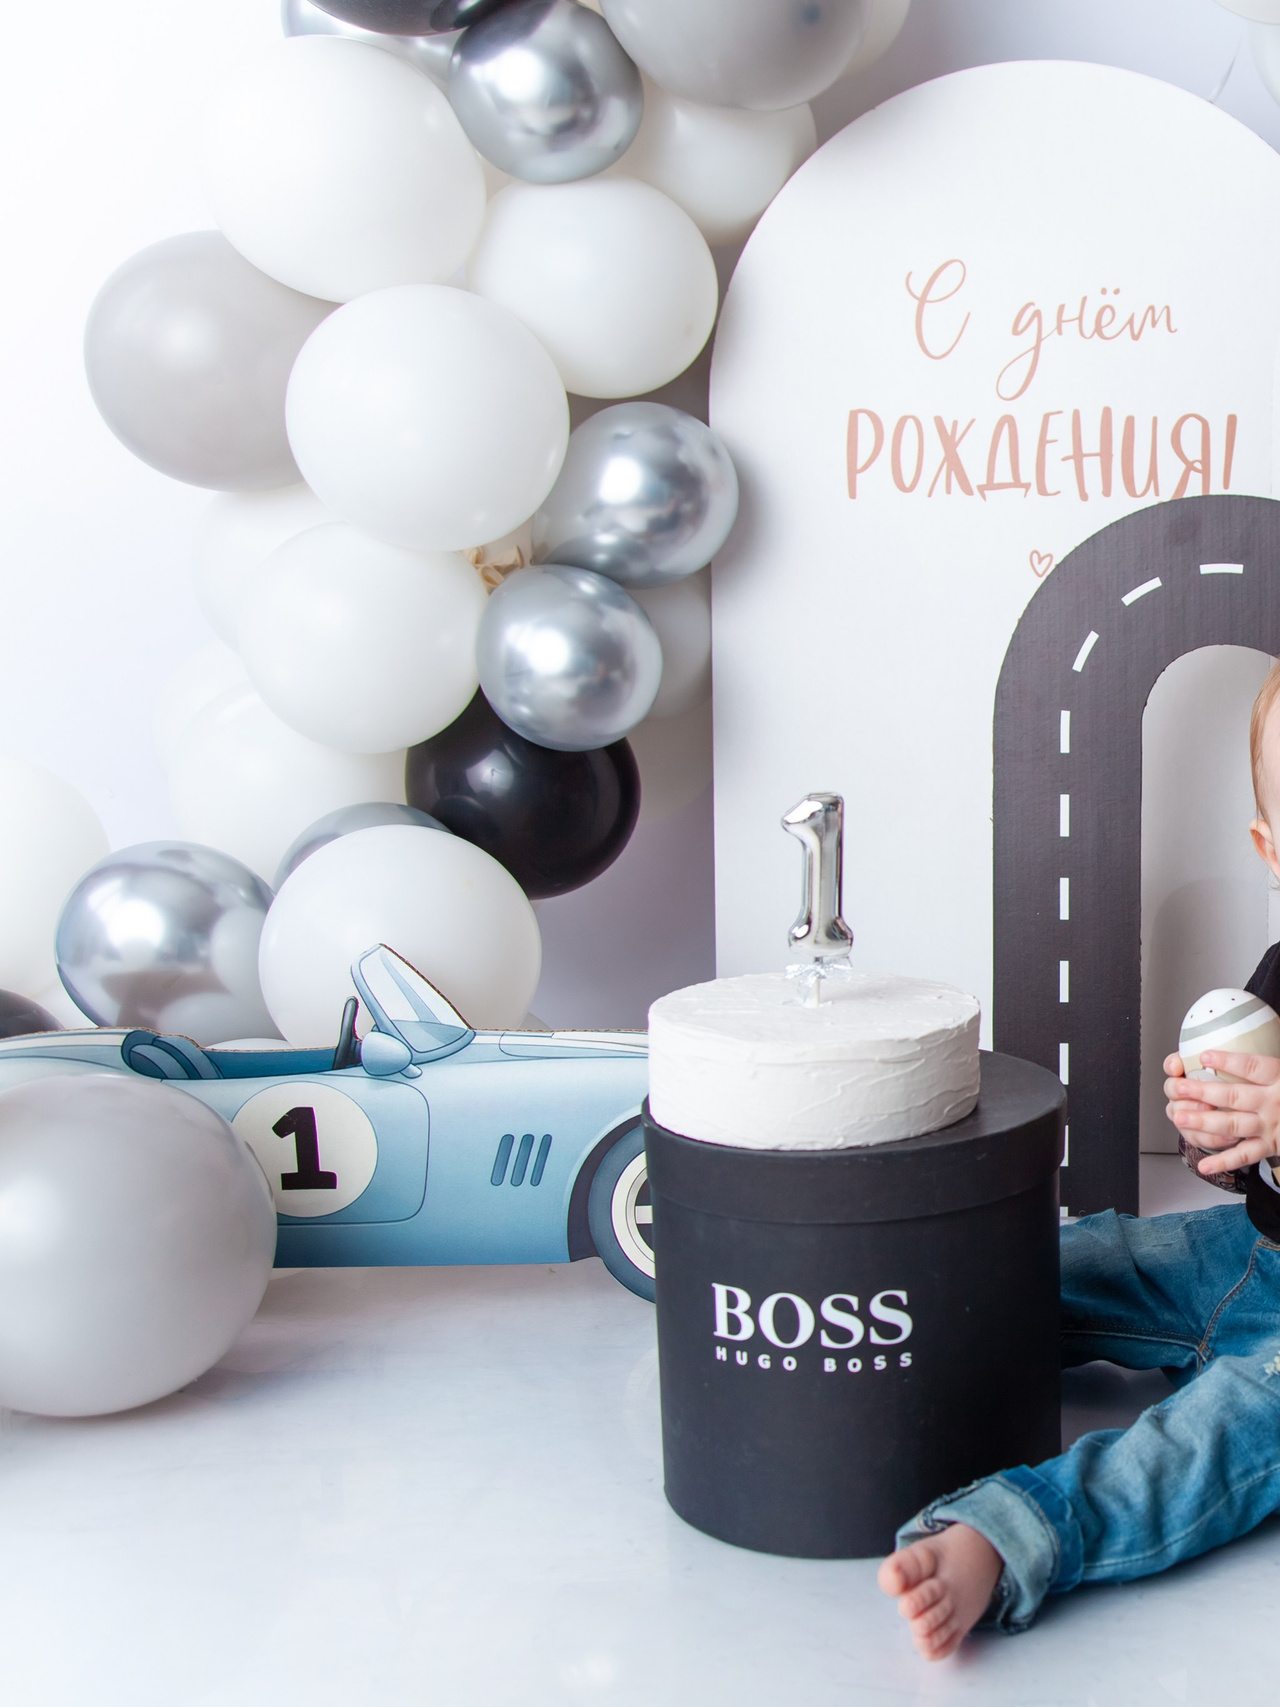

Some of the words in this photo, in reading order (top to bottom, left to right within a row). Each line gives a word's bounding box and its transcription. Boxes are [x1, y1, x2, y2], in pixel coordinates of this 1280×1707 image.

[905, 258, 971, 360] С
[996, 286, 1178, 401] днём
[845, 405, 1238, 503] РОЖДЕНИЯ!
[780, 791, 854, 957] 1
[271, 1105, 338, 1190] 1
[711, 1282, 914, 1350] BOSS
[715, 1345, 798, 1372] HUGO
[822, 1351, 913, 1373] BOSS
